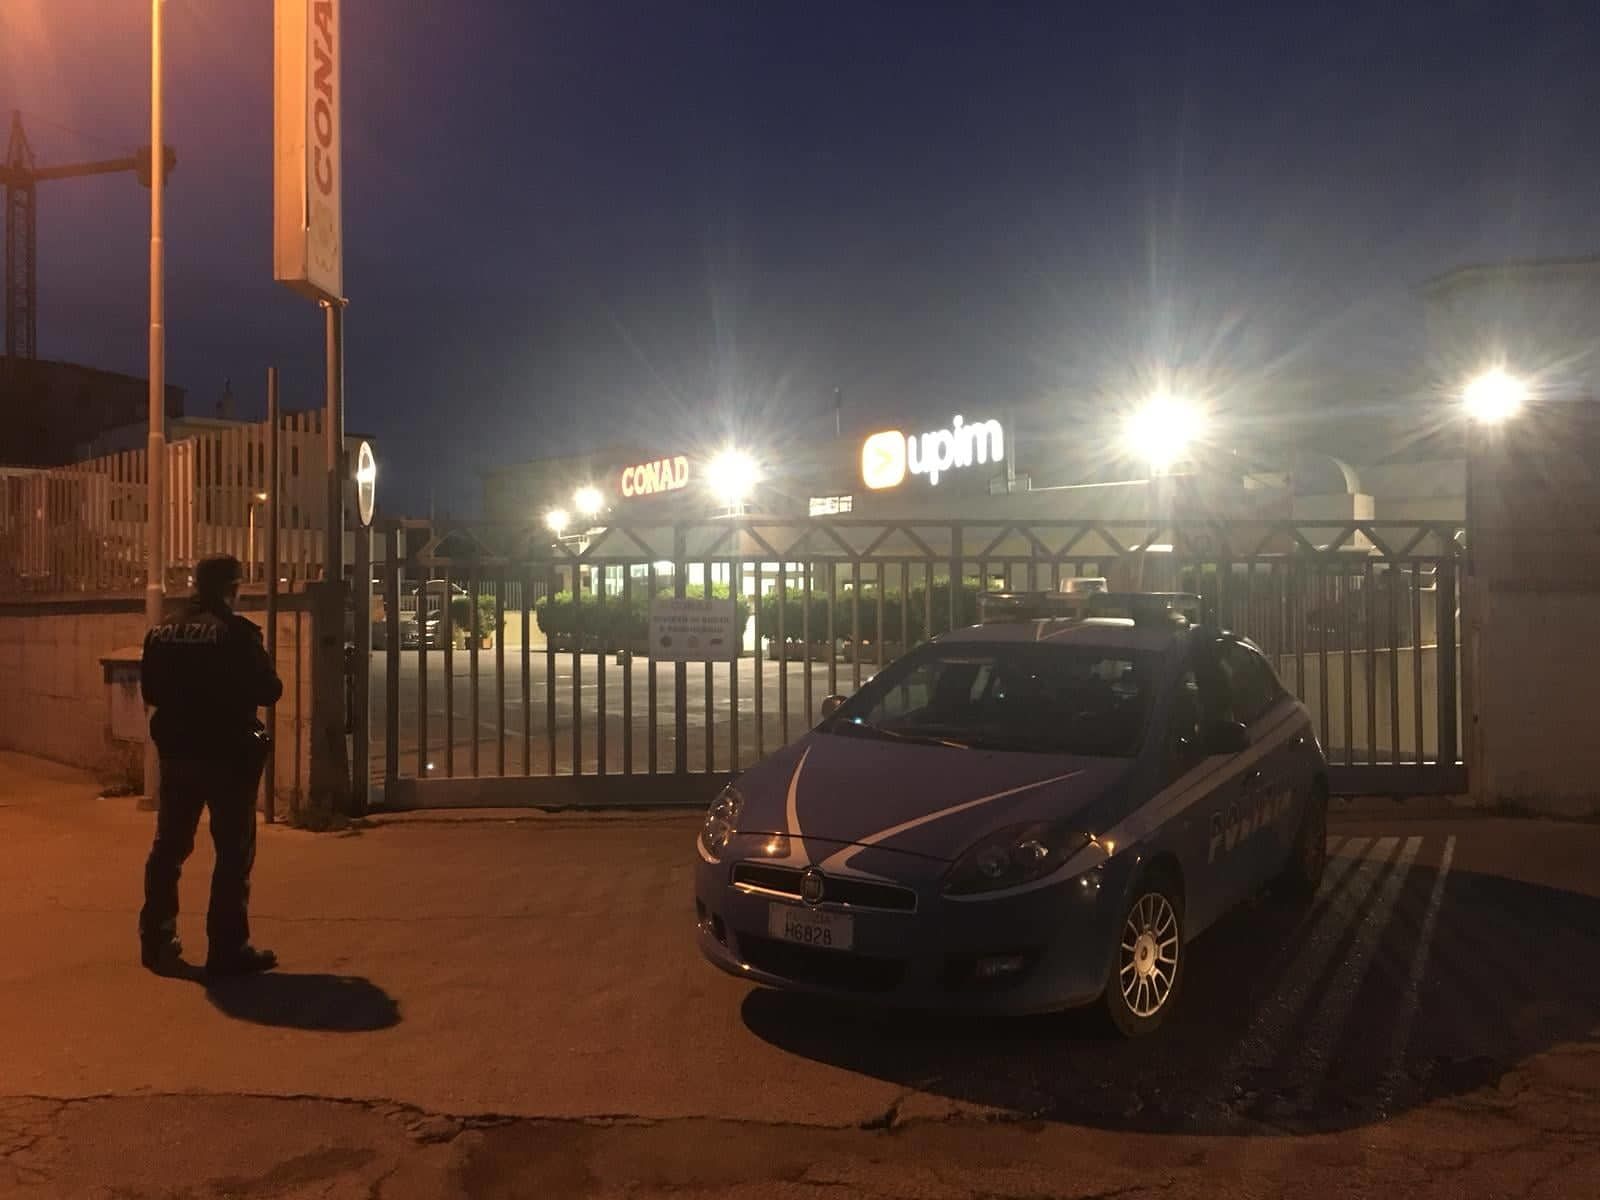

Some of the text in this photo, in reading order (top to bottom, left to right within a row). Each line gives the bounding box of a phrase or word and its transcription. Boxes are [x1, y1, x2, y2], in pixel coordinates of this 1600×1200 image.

[907, 414, 1004, 486] upim
[621, 455, 689, 497] CONAD
[150, 623, 217, 644] POLIZIA
